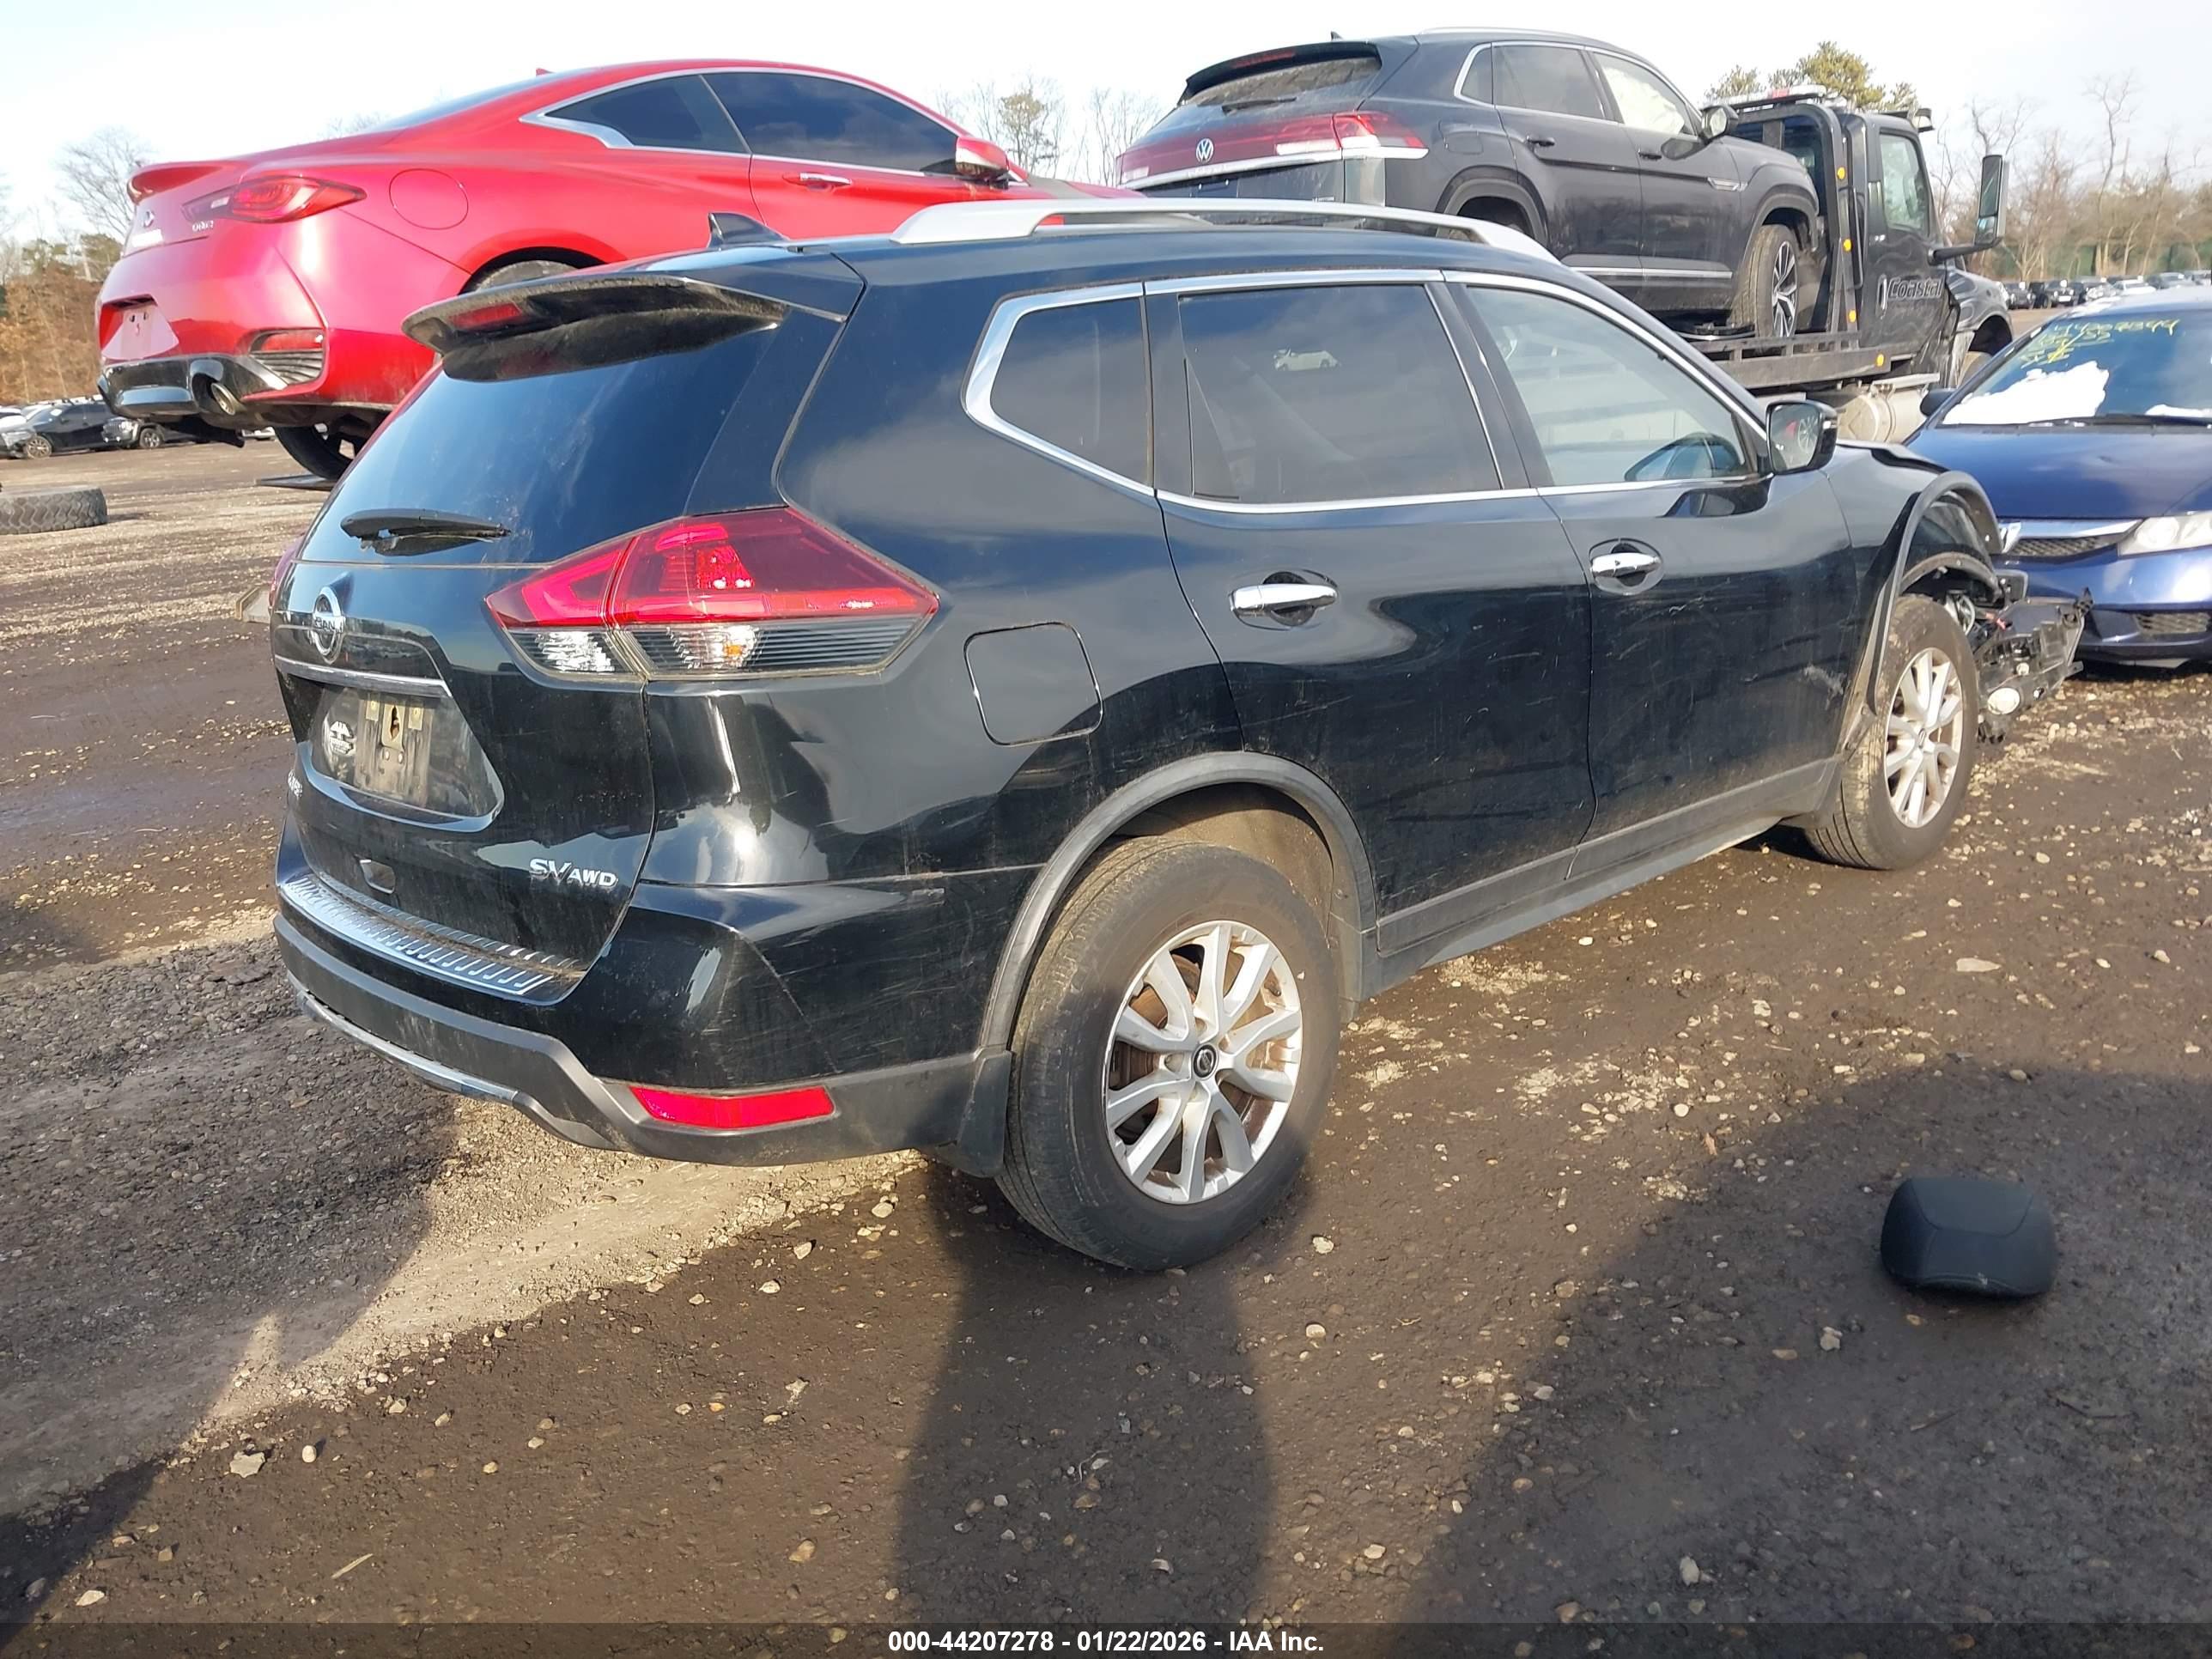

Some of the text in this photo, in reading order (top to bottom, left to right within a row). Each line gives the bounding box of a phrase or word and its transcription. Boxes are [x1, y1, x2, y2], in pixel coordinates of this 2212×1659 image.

[1888, 276, 1947, 301] Coastal
[530, 858, 618, 888] SV AWD
